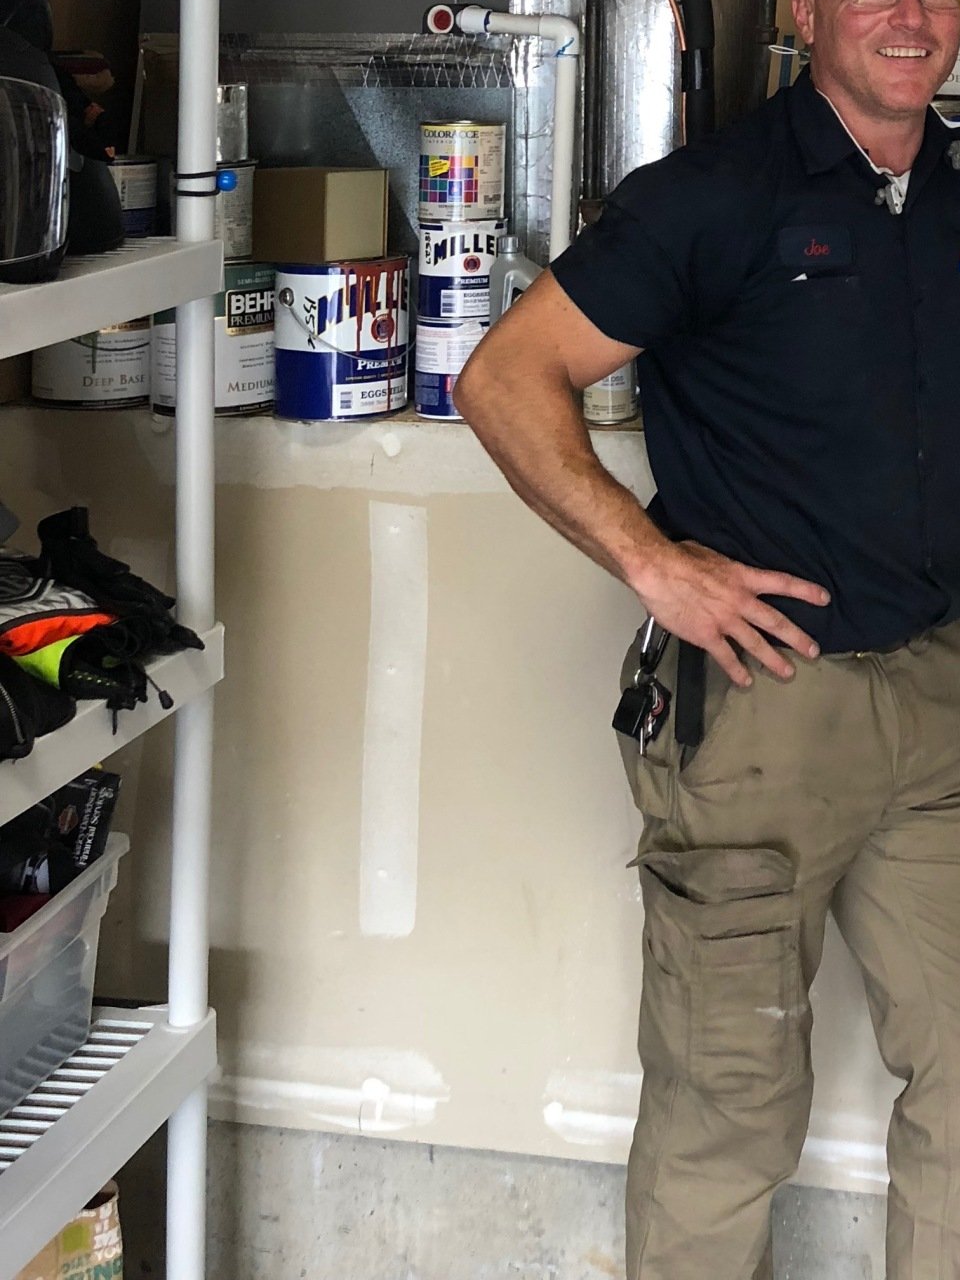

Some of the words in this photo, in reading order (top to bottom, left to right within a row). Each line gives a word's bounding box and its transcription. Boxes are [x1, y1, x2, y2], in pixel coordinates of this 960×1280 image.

[804, 238, 831, 256] Joe
[82, 375, 114, 388] DEEP
[120, 373, 146, 385] BASE
